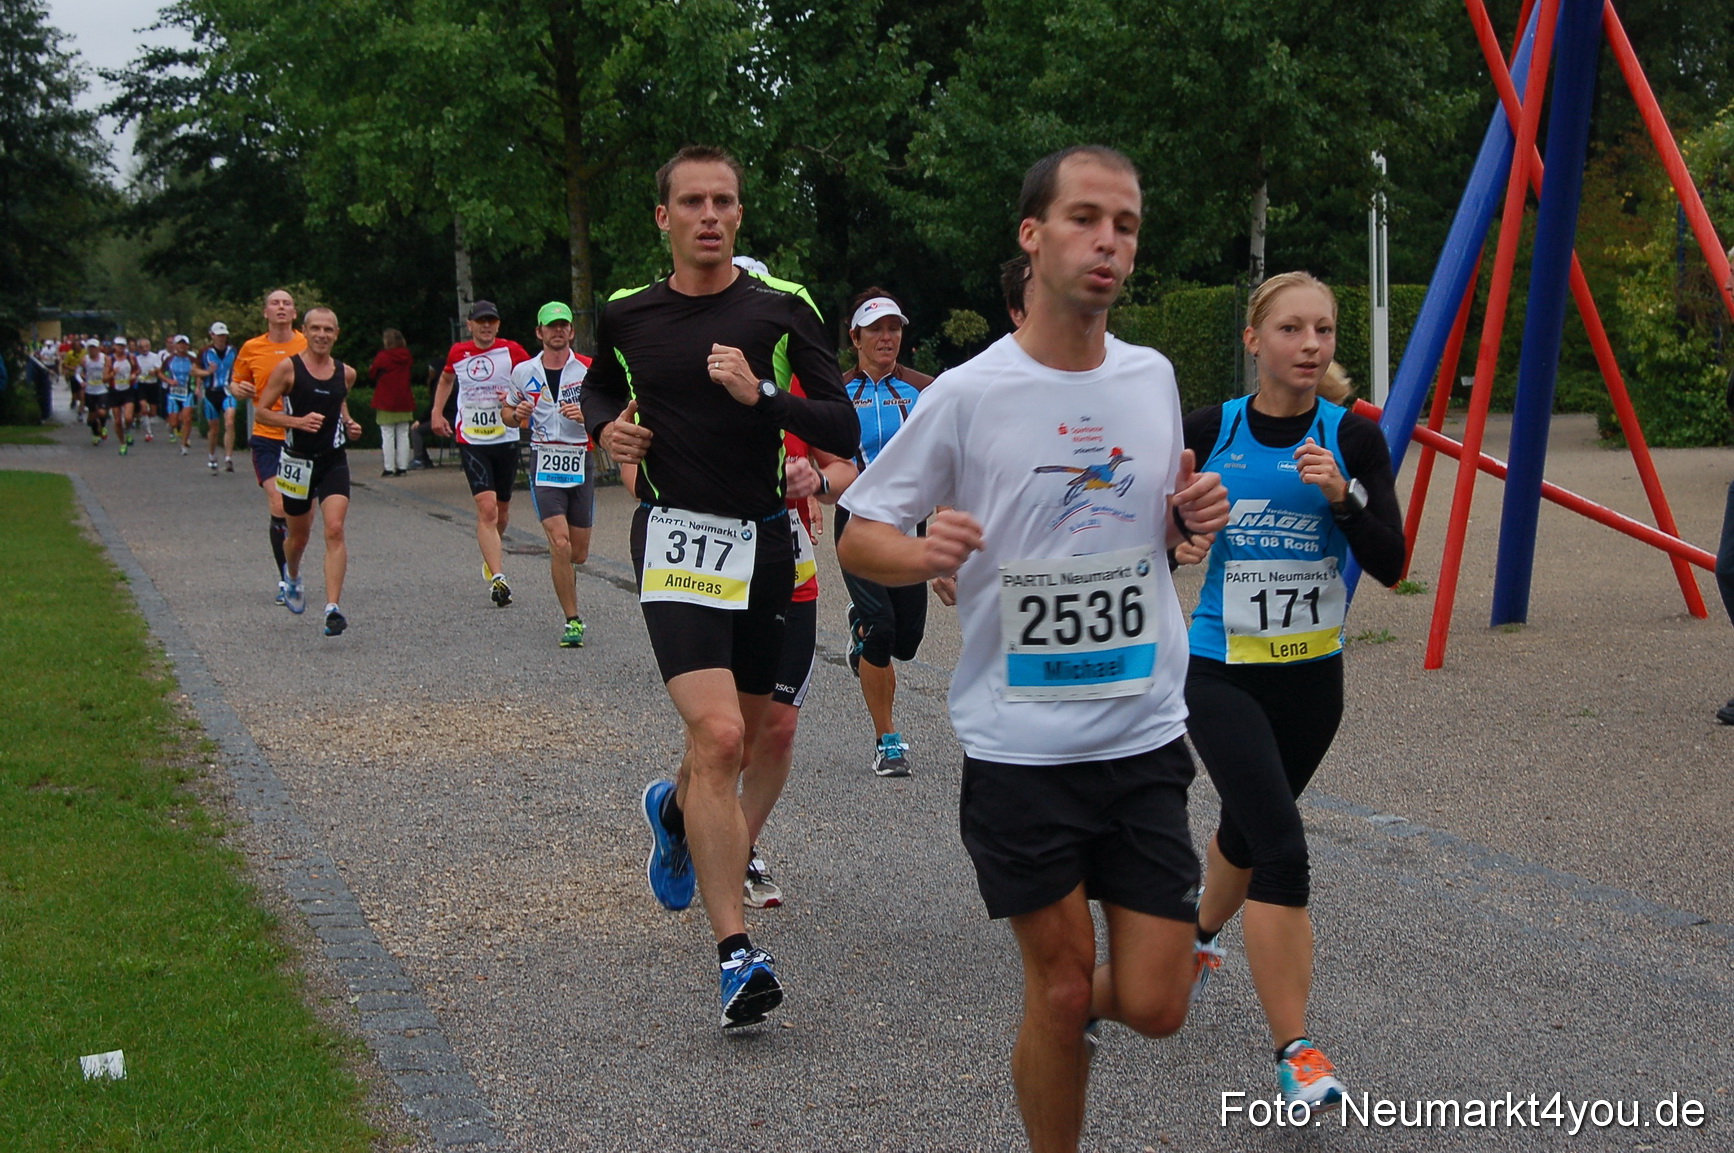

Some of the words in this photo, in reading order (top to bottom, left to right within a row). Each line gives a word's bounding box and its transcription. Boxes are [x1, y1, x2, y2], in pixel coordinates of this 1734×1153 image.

[472, 411, 497, 426] 404
[542, 454, 581, 472] 2986
[650, 515, 687, 527] PARTL
[688, 521, 738, 538] Neumarkt
[1239, 514, 1321, 532] NAGEL
[665, 530, 734, 572] 317
[1260, 536, 1280, 548] 08
[1284, 538, 1320, 552] Roth
[664, 573, 722, 595] Andreas
[1002, 573, 1057, 587] PARTL
[1060, 565, 1133, 585] Neumarkt
[1225, 571, 1266, 583] PARTL
[1269, 571, 1330, 583] Neumarkt
[1019, 585, 1145, 646] 2536
[1250, 586, 1320, 631] 171
[1270, 641, 1308, 658] Lena
[1043, 654, 1126, 681] Michael
